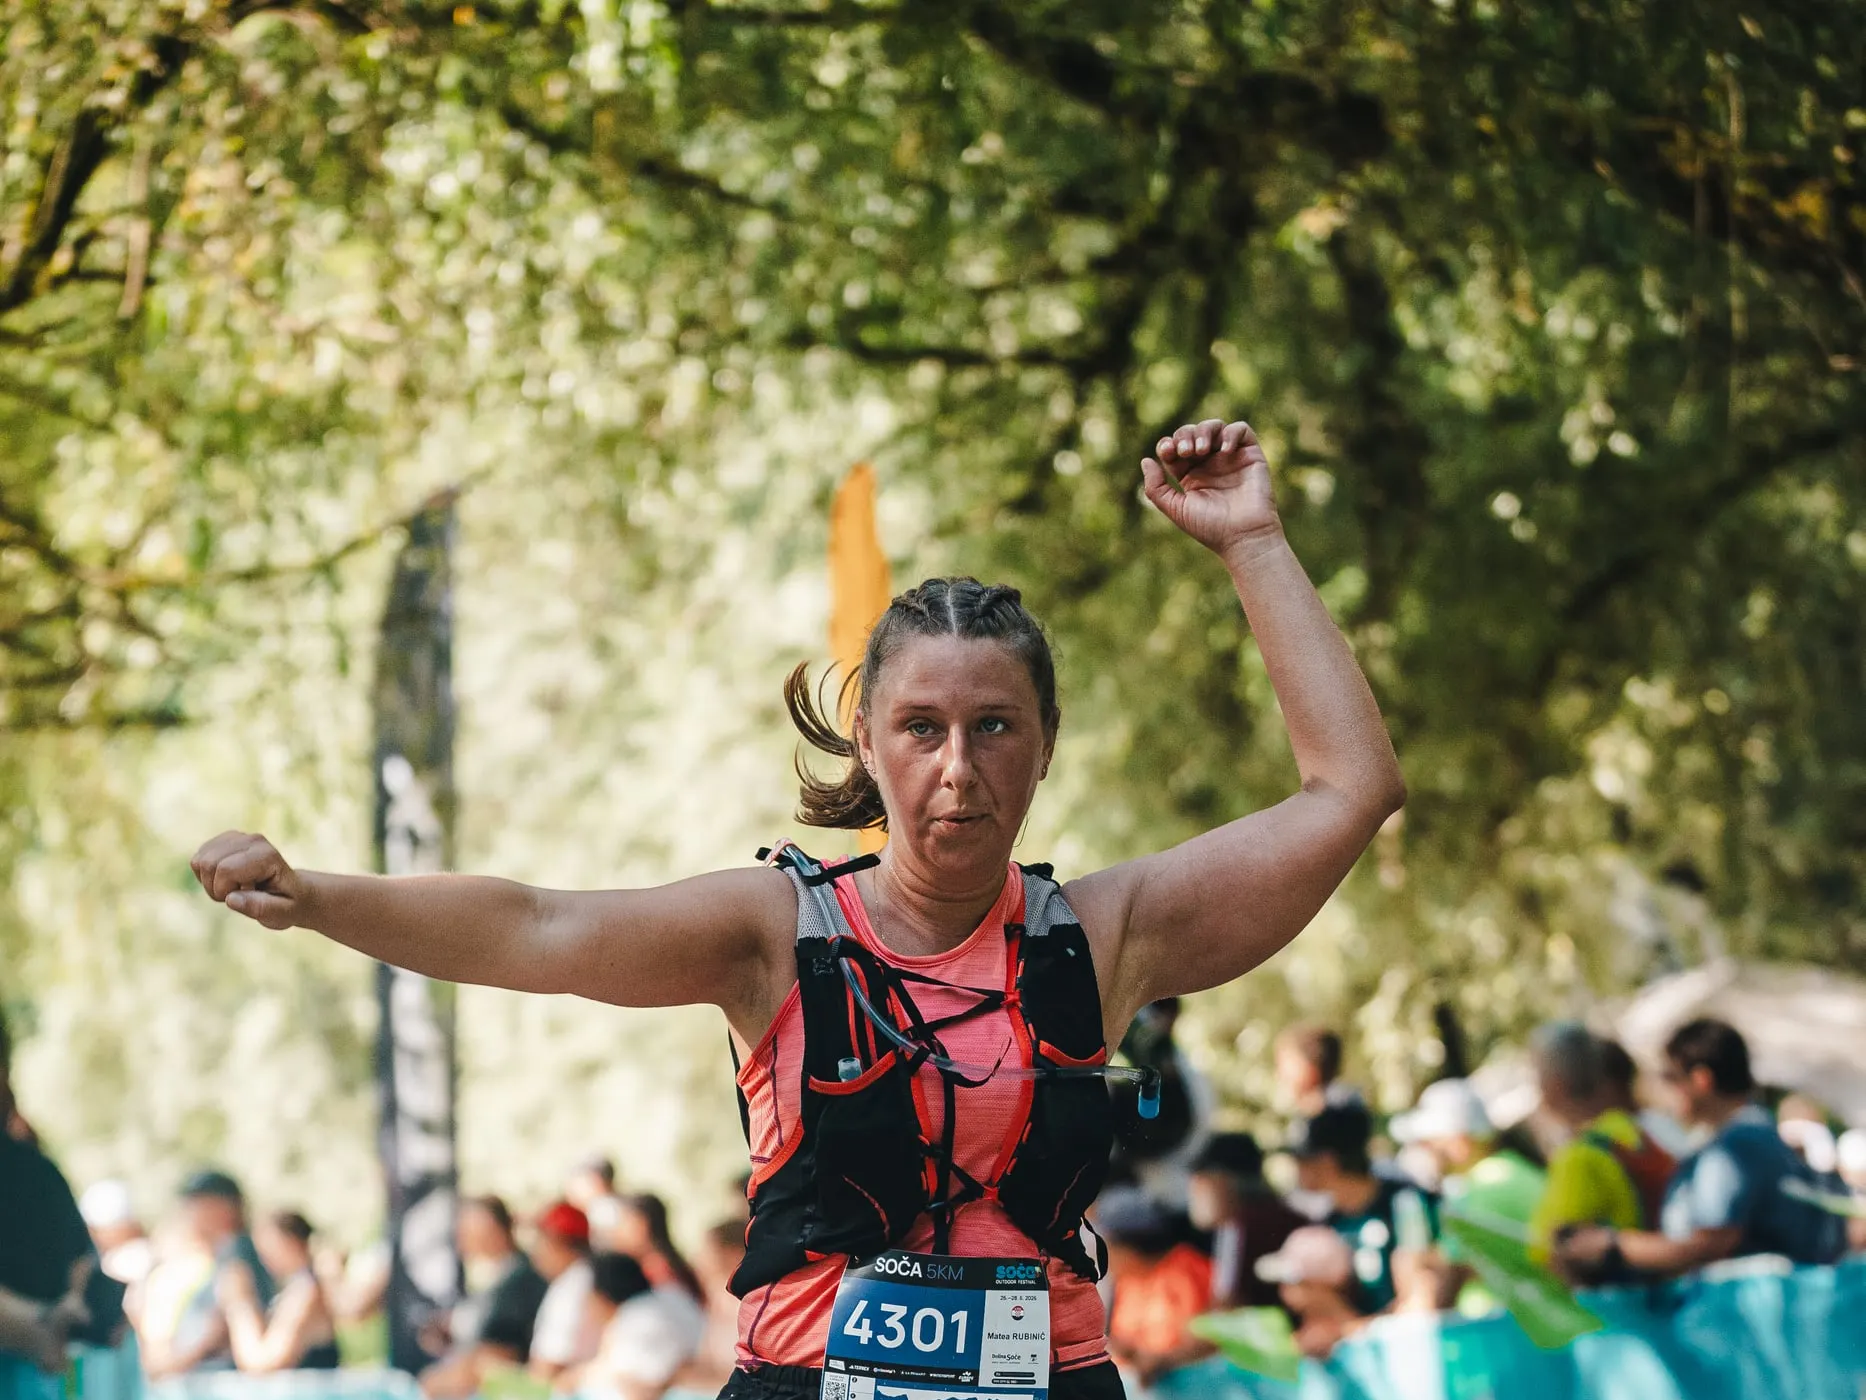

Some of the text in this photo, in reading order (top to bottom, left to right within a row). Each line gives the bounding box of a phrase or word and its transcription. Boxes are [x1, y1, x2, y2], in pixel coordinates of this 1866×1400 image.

[874, 1255, 964, 1281] SOČA 5KM
[843, 1299, 969, 1354] 4301
[987, 1332, 1010, 1340] Matea
